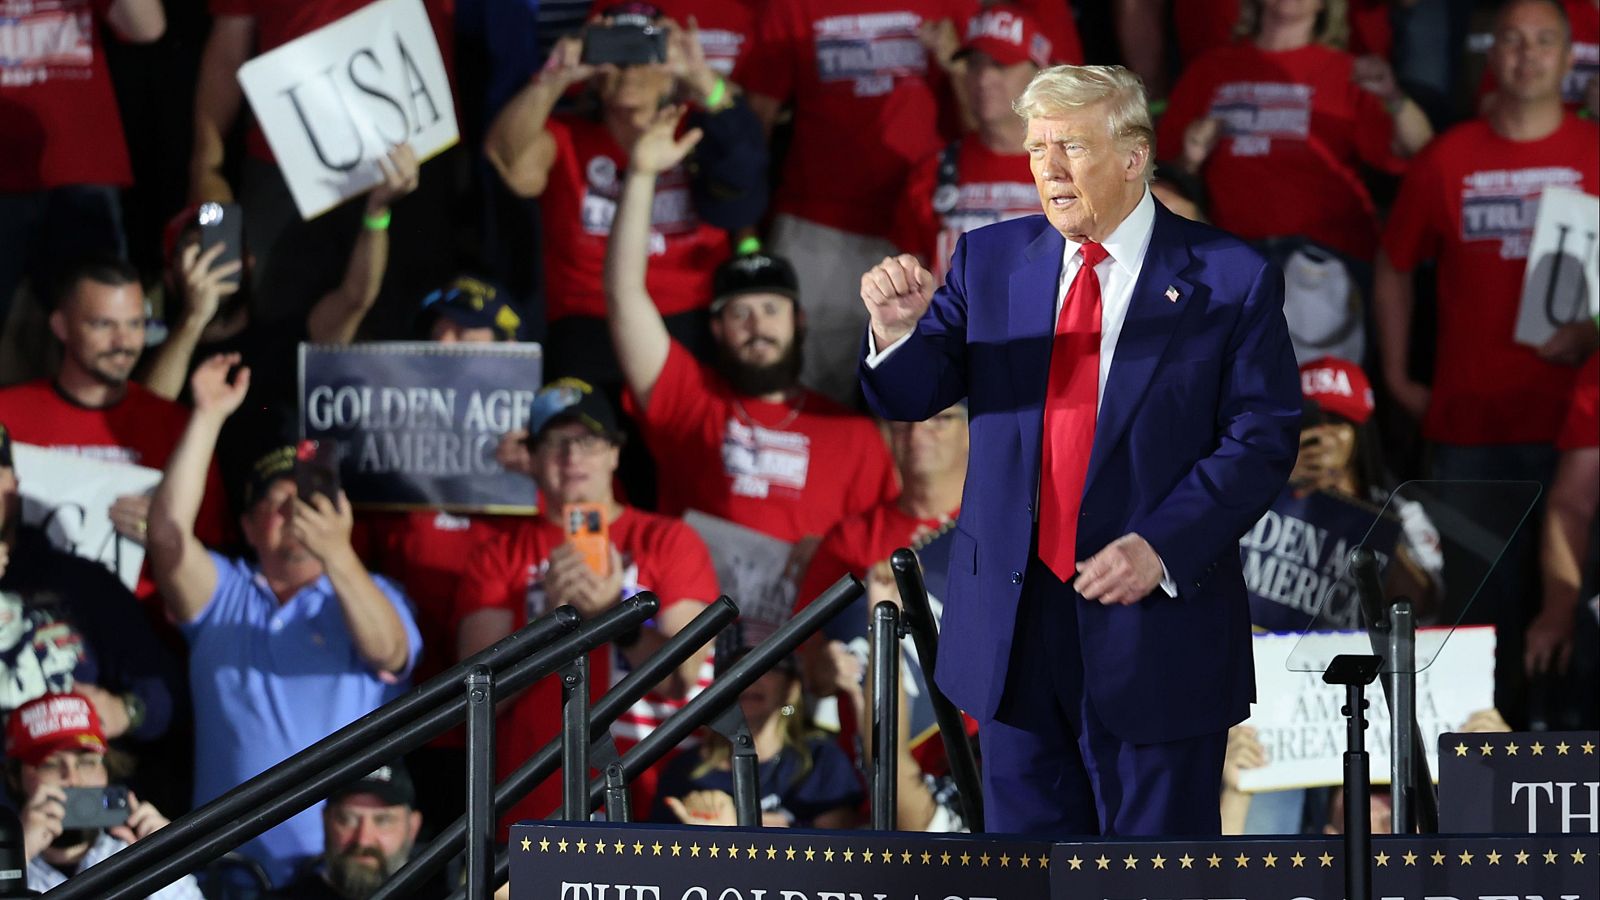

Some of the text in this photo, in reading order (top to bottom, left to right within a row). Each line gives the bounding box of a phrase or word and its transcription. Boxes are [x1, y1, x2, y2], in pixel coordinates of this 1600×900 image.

[278, 31, 440, 171] USA
[1302, 368, 1353, 397] USA
[308, 385, 457, 432] GOLDEN
[360, 431, 498, 477] AMERIC
